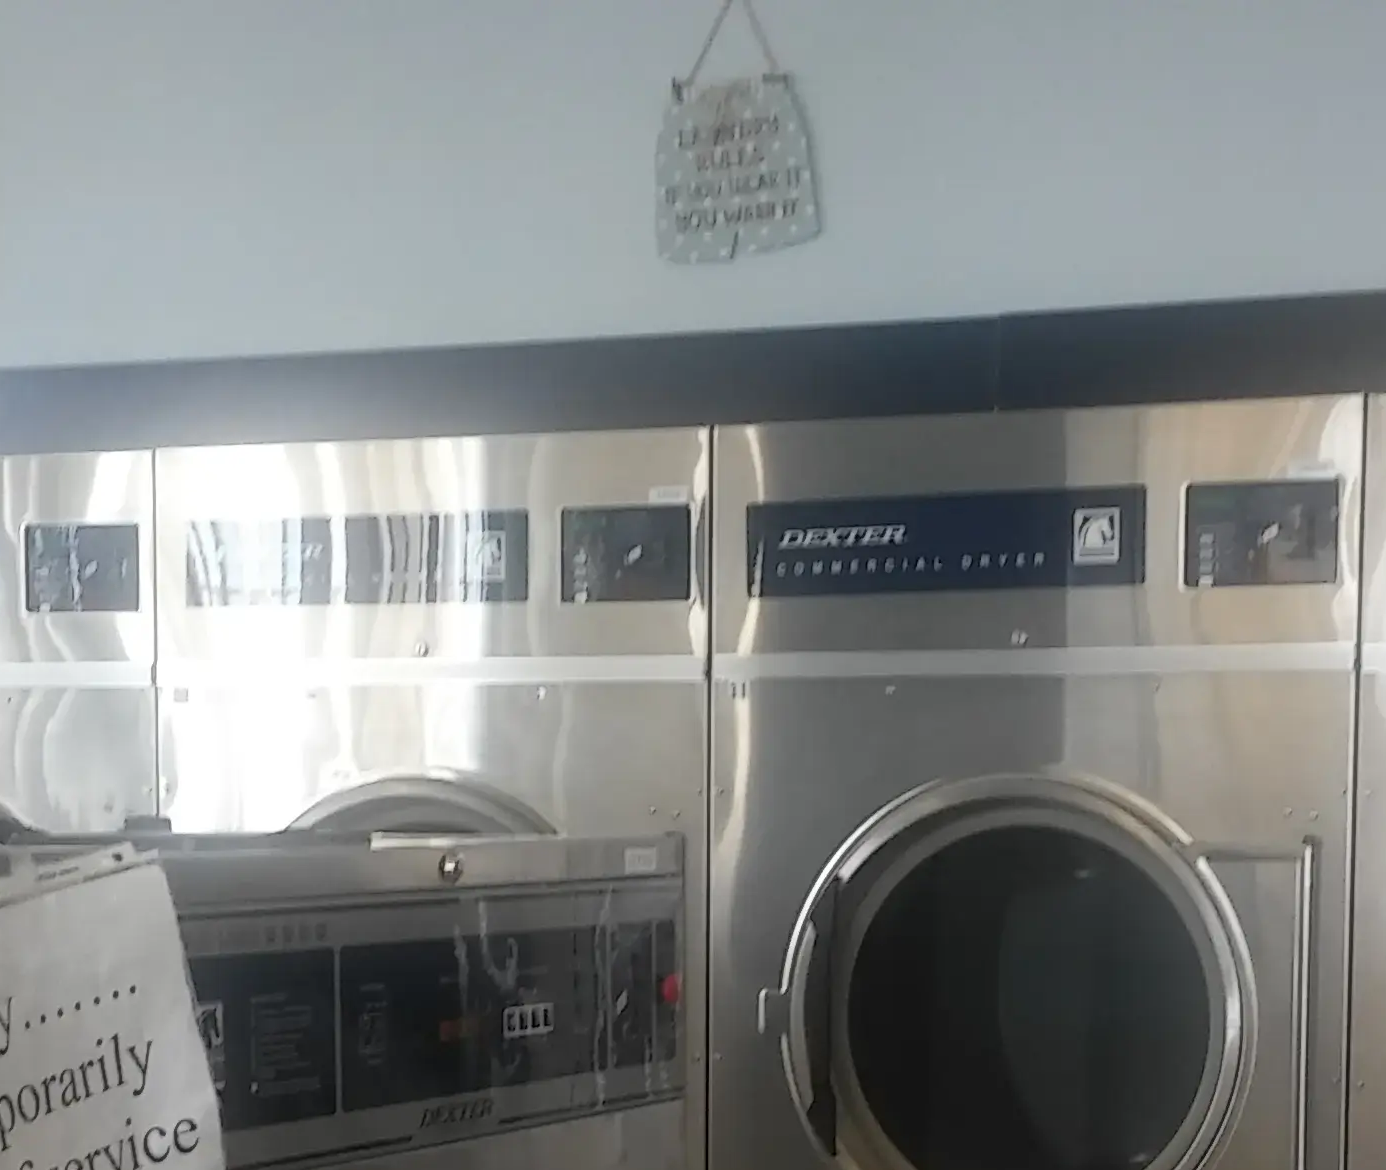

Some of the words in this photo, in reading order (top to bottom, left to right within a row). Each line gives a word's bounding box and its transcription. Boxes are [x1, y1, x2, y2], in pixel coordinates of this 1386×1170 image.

[778, 523, 907, 550] DEXTER
[776, 556, 943, 578] COMMERCIAL
[961, 551, 1046, 571] DRYER
